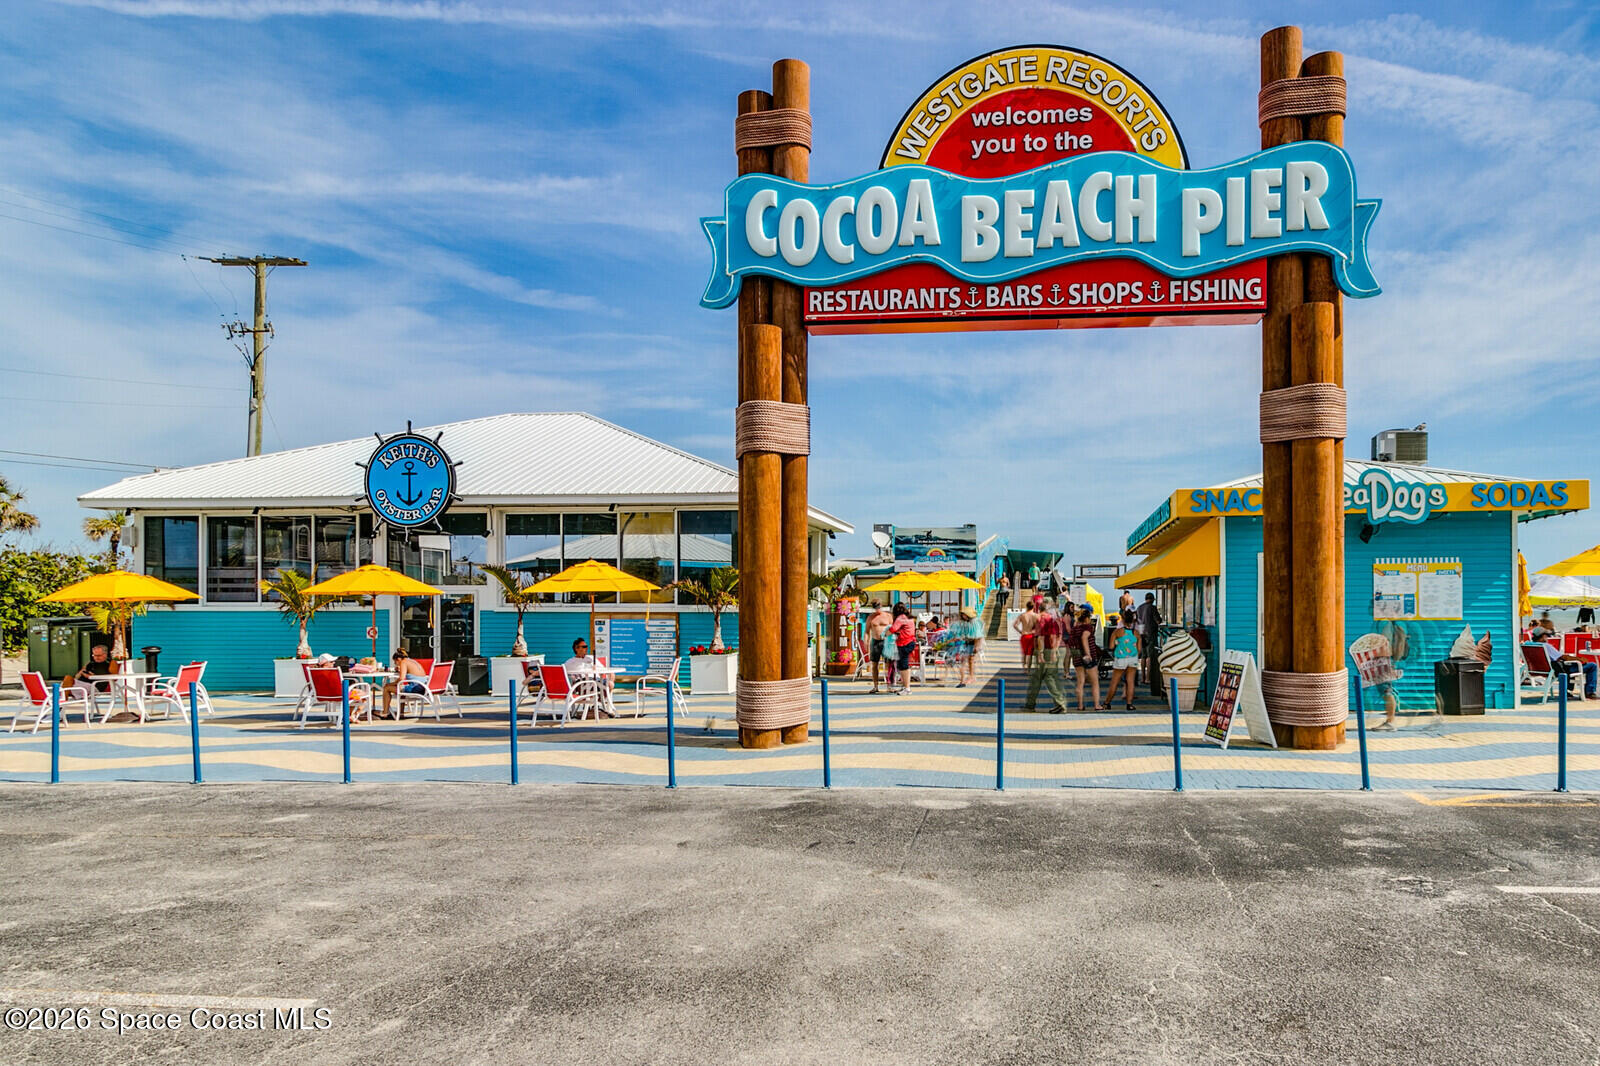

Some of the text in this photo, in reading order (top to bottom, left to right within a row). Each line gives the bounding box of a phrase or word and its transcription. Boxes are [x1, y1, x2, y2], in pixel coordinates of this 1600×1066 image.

[895, 55, 1168, 160] WESTGATE RESORTS
[971, 106, 1093, 128] welcomes
[971, 131, 1093, 159] you to the
[745, 160, 1330, 267] COCOA BEACH PIER
[809, 277, 1262, 313] RESTAURANTS BARS SHOPS FISHING
[379, 443, 440, 469] KEITH'S
[375, 487, 444, 521] OYSTER BAR
[1190, 488, 1263, 513] SNAC
[1344, 471, 1445, 521] eaDogs
[1471, 481, 1569, 508] SODAS
[1406, 564, 1429, 572] MENU
[839, 615, 849, 648] ATM
